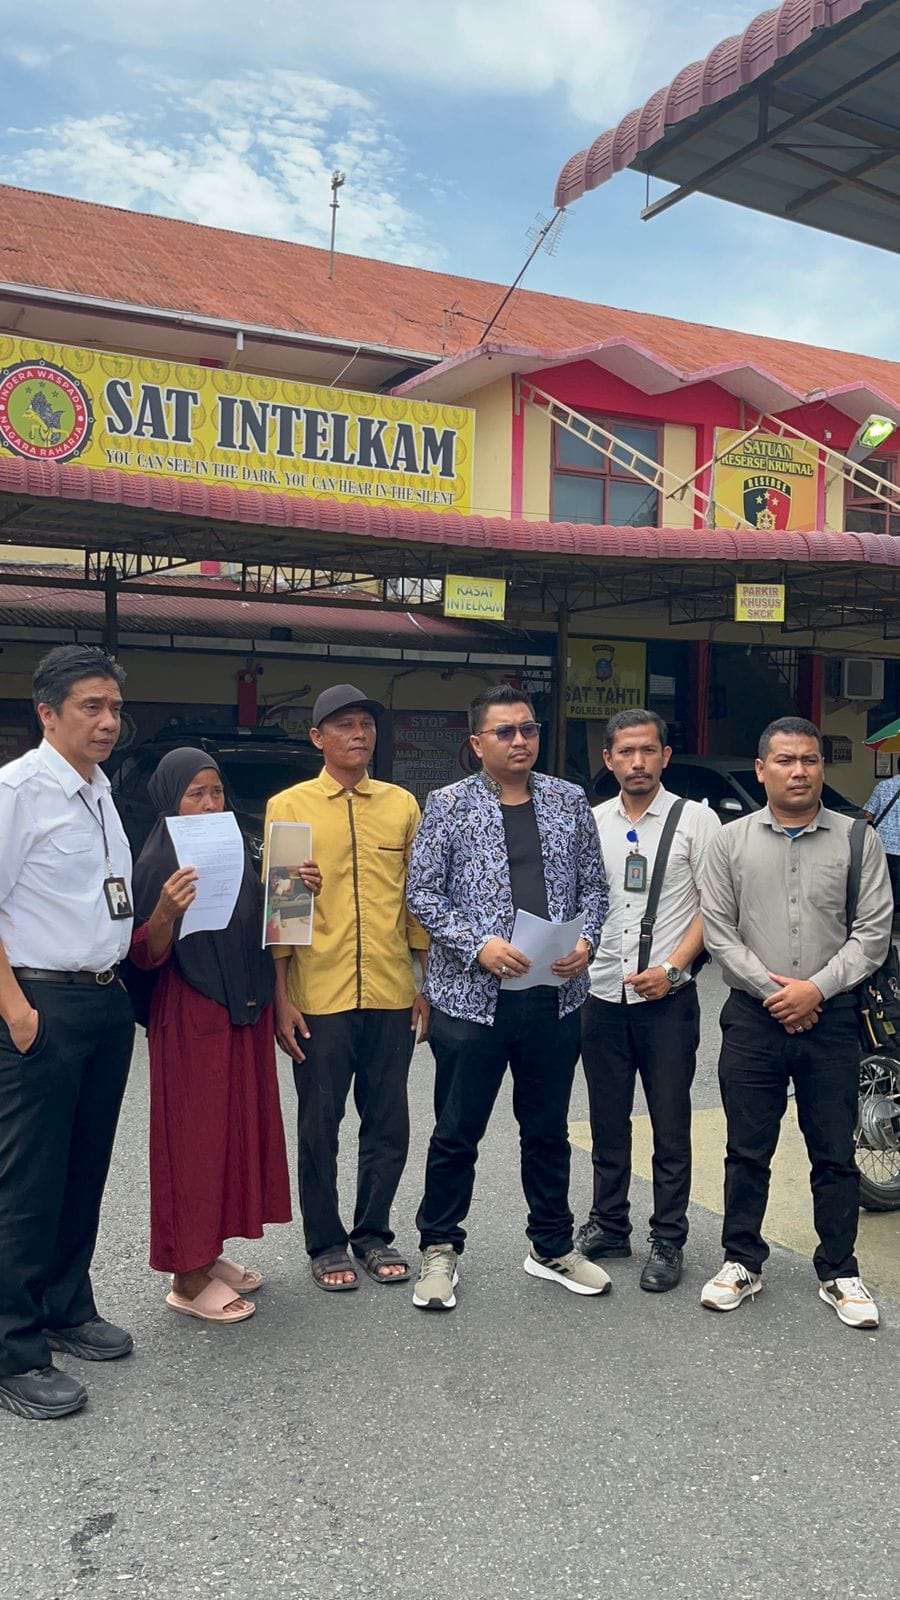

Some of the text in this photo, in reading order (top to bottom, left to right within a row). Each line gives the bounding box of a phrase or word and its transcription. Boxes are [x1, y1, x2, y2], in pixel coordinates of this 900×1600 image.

[1, 370, 83, 411] INDERA WASPADA
[0, 415, 83, 457] NAGARA RAHARJA
[105, 378, 457, 478] SAT INTELKAM
[744, 439, 793, 460] SATUAN
[721, 454, 813, 477] RESERSE KRIMINAL
[106, 449, 455, 505] YOU CAN SEE IN THE DARK, YOU CAN HEAR IN THE SILENT
[748, 476, 786, 492] RESERSE
[457, 585, 493, 597] KASAT
[743, 586, 778, 597] PARKIR
[447, 600, 505, 612] INTELKAM
[740, 597, 782, 608] KHUSUS
[747, 609, 775, 619] SKCK
[566, 686, 641, 705] SAT TAHTI
[570, 706, 603, 715] POLRES
[411, 716, 447, 727] STOP
